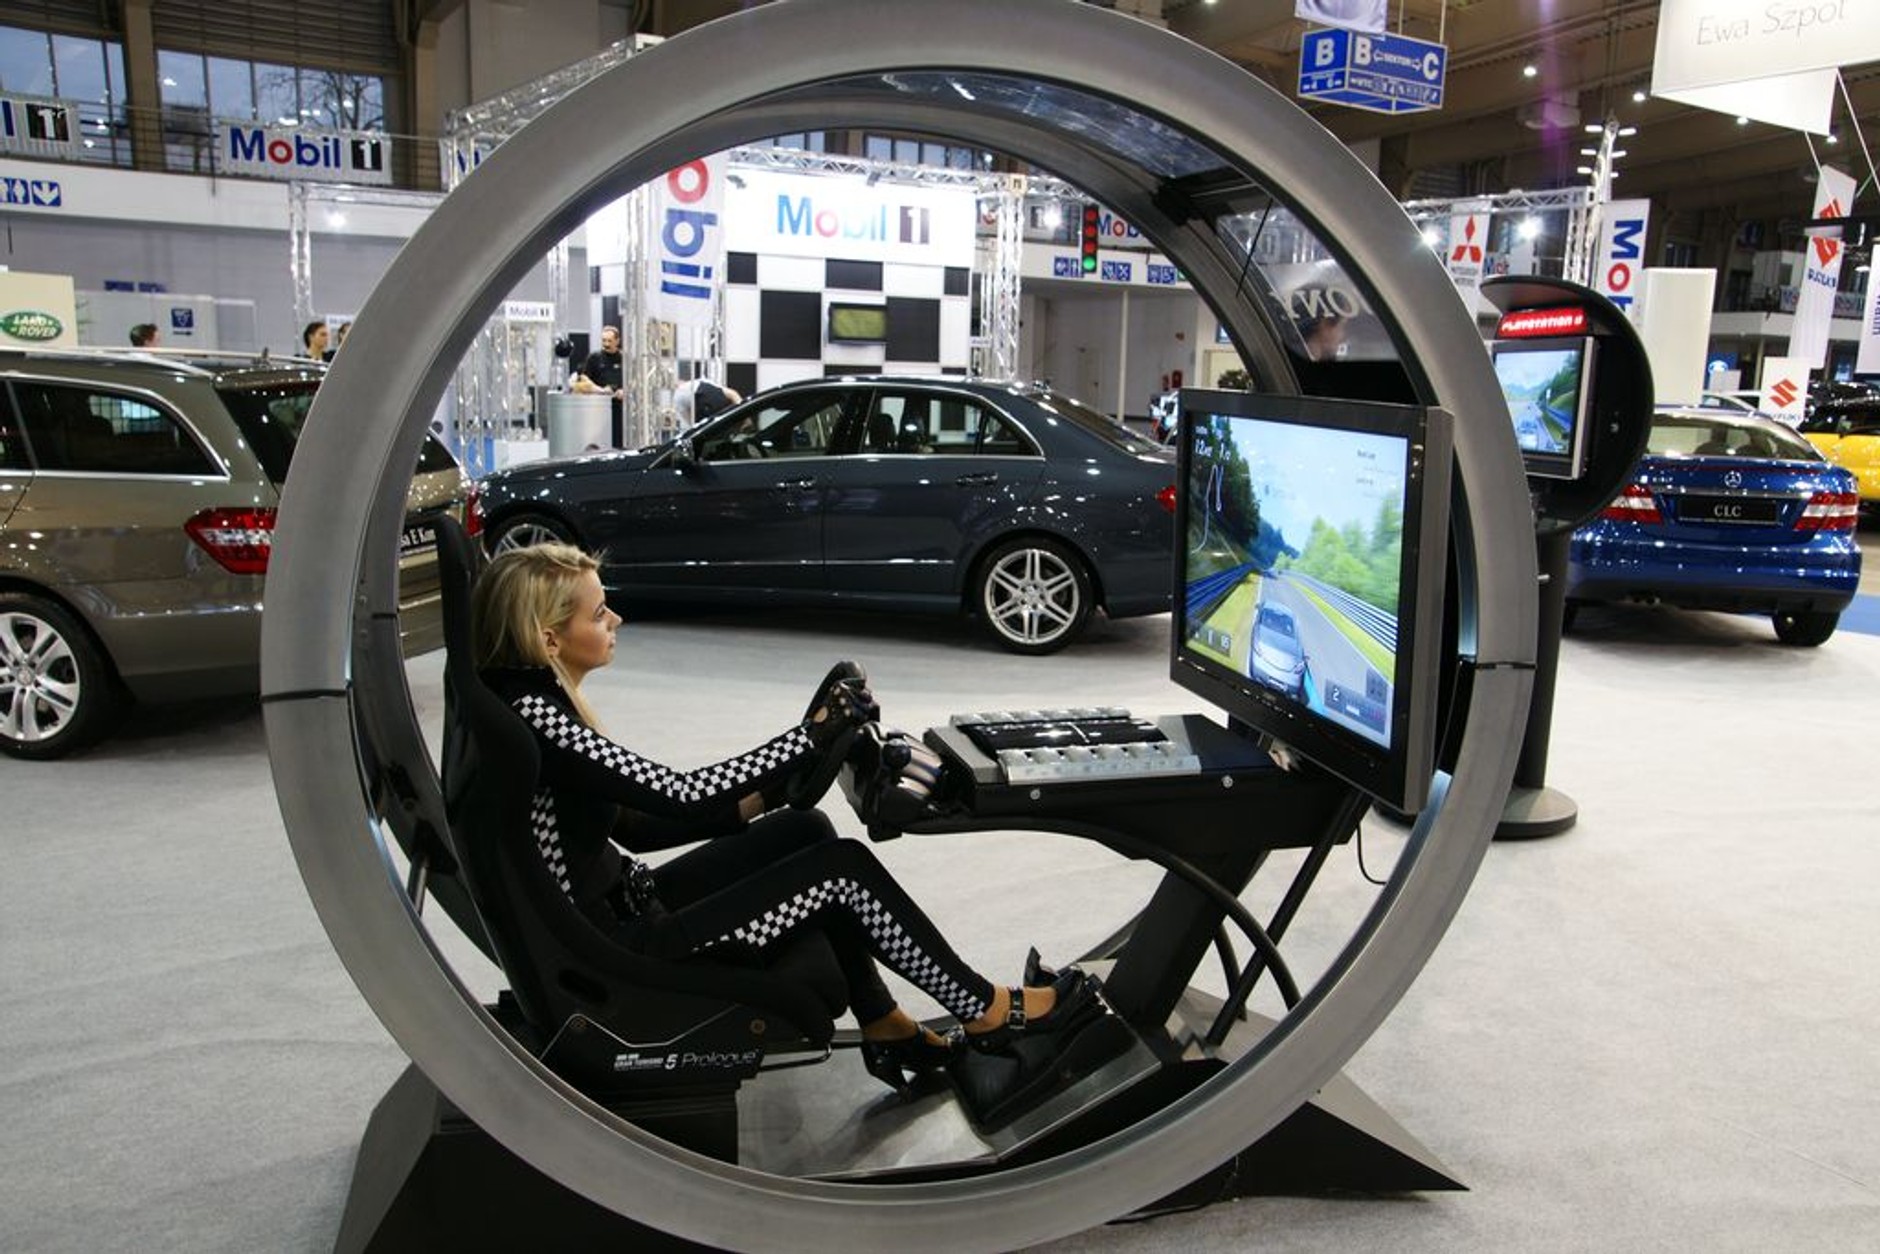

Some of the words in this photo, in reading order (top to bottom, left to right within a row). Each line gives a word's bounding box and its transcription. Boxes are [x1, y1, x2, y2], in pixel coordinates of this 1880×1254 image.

[1697, 15, 1749, 45] Ewa
[1316, 39, 1335, 66] B
[1354, 36, 1372, 66] B
[1423, 52, 1440, 81] C
[229, 127, 341, 168] Mobil
[660, 157, 717, 300] obil
[776, 194, 887, 242] Mobil
[13, 315, 48, 326] LAND
[17, 325, 58, 338] ROVER
[1713, 504, 1743, 518] CLC
[665, 1053, 679, 1070] 5
